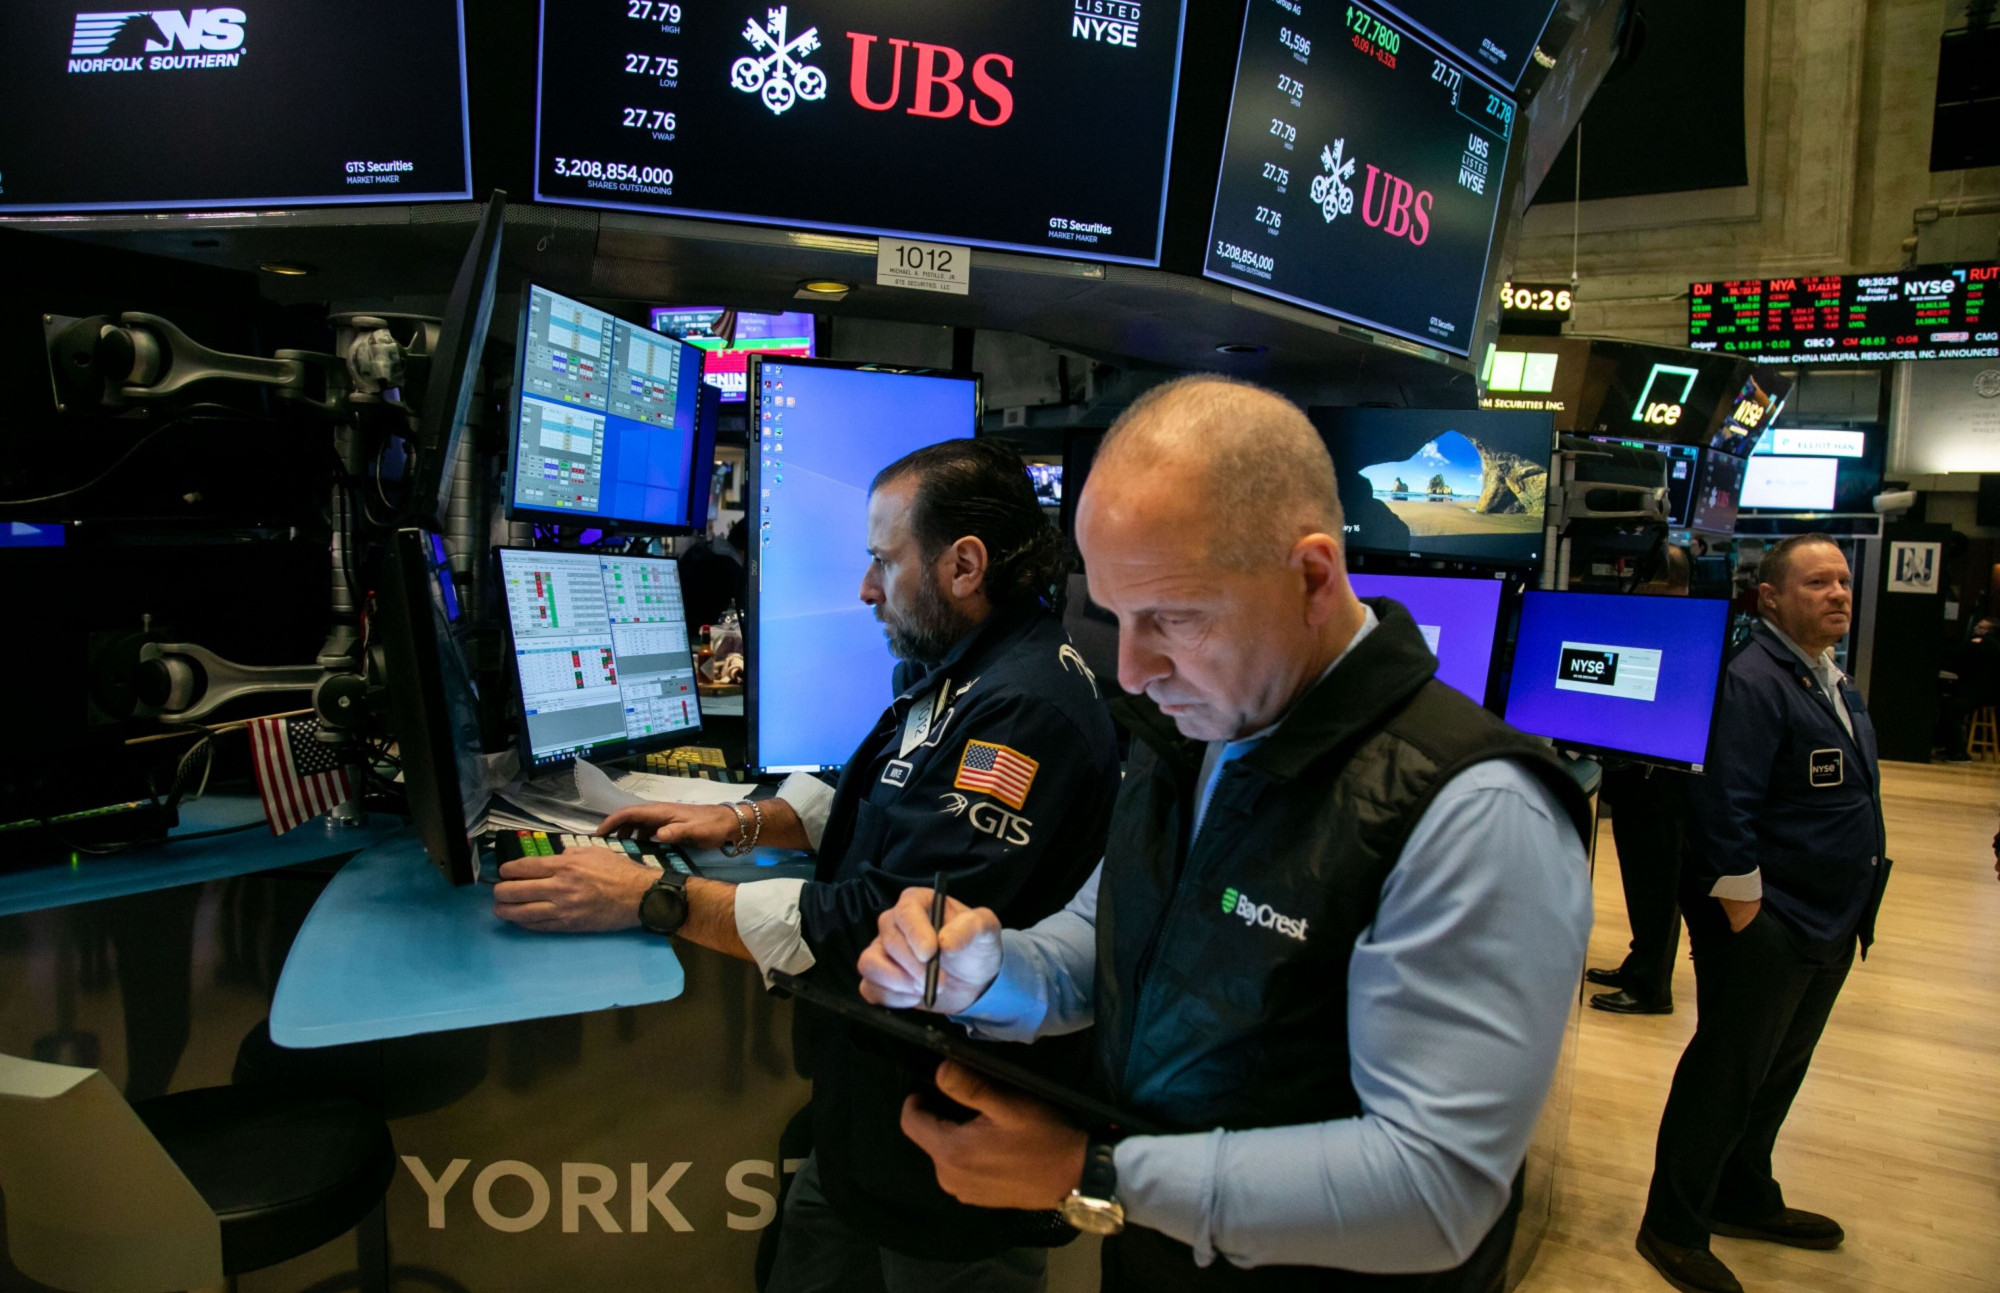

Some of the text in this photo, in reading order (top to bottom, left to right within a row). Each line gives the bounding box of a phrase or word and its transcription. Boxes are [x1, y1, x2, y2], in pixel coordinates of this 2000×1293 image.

[627, 0, 681, 23] 27.79
[1075, 0, 1141, 20] LISTED
[1292, 4, 1301, 16] AG
[661, 24, 680, 34] HIGH
[1072, 15, 1139, 48] NYSE
[1353, 10, 1400, 55] 27.7800
[1280, 27, 1311, 56] 91,596
[68, 53, 240, 73] NORFOLK SOUTHERN
[625, 53, 679, 77] 27.75
[660, 79, 678, 88] LOW
[846, 31, 1014, 127] UBS
[1431, 59, 1461, 91] 27.77
[1277, 74, 1304, 99] 27.75
[1450, 91, 1458, 106] 3
[623, 107, 676, 131] 27.76
[1486, 94, 1512, 124] 27.78
[652, 132, 675, 141] VWAP
[1270, 118, 1297, 142] 27.79
[1468, 133, 1489, 158] UBS
[346, 160, 413, 173] GTS Securities
[554, 157, 673, 185] 3,208,854,000
[1262, 162, 1289, 185] 27.75
[1462, 154, 1487, 175] LISTED
[346, 175, 400, 184] MARKET MAKER
[587, 180, 672, 195] SHARES OUTSTANDING
[1458, 168, 1485, 195] NYSE
[1362, 164, 1433, 246] UBS
[1049, 217, 1112, 235] GTS Securities
[1255, 206, 1282, 228] 27.76
[1049, 230, 1098, 243] MARKET MAKER
[896, 245, 952, 272] 1012
[1216, 240, 1274, 272] 3,208,854,000
[895, 278, 905, 286] GTS
[1858, 276, 1899, 288] 09:30:26
[1969, 267, 2000, 280] RUT
[1694, 283, 1713, 296] DJI
[1770, 279, 1797, 292] NYA
[1866, 287, 1889, 295] Friday
[1856, 294, 1888, 302] February
[1724, 341, 1736, 350] CL
[1804, 338, 1826, 348] CIBC
[1842, 337, 1859, 346] CM
[1975, 331, 1998, 341] CMG
[1792, 353, 1819, 363] CHINA
[1820, 351, 1860, 362] NATURAL
[1861, 350, 1917, 361] RESOURCES,
[1919, 349, 1937, 359] INC.
[1939, 347, 2000, 358] ANNOUNCES
[968, 801, 1033, 846] GTS
[1235, 894, 1309, 941] BayCrest
[400, 1155, 809, 1234] YORK S
